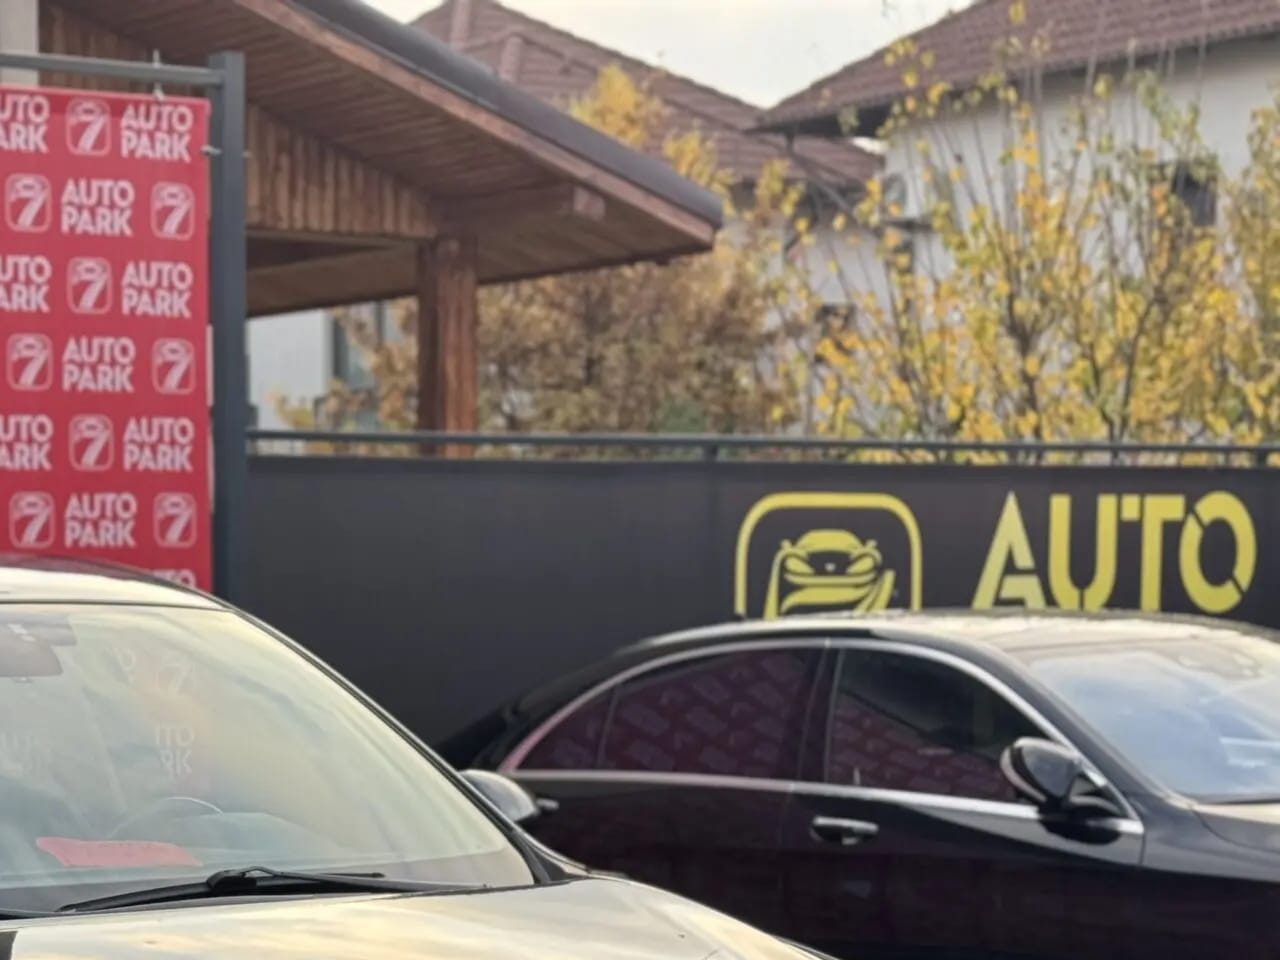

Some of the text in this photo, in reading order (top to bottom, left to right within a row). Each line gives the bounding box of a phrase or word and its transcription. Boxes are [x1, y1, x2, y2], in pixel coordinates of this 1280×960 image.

[121, 104, 193, 133] AUTO
[121, 133, 191, 163] PARK
[61, 178, 134, 208] AUTO
[61, 207, 134, 237] PARK
[122, 260, 193, 290] AUTO
[122, 289, 192, 319] PARK
[62, 336, 135, 365] AUTO
[62, 365, 134, 393] PARK
[124, 417, 194, 444] AUTO
[124, 444, 193, 472] PARK
[64, 493, 137, 521] AUTO
[65, 520, 135, 548] PARK
[972, 489, 1257, 614] AUTO
